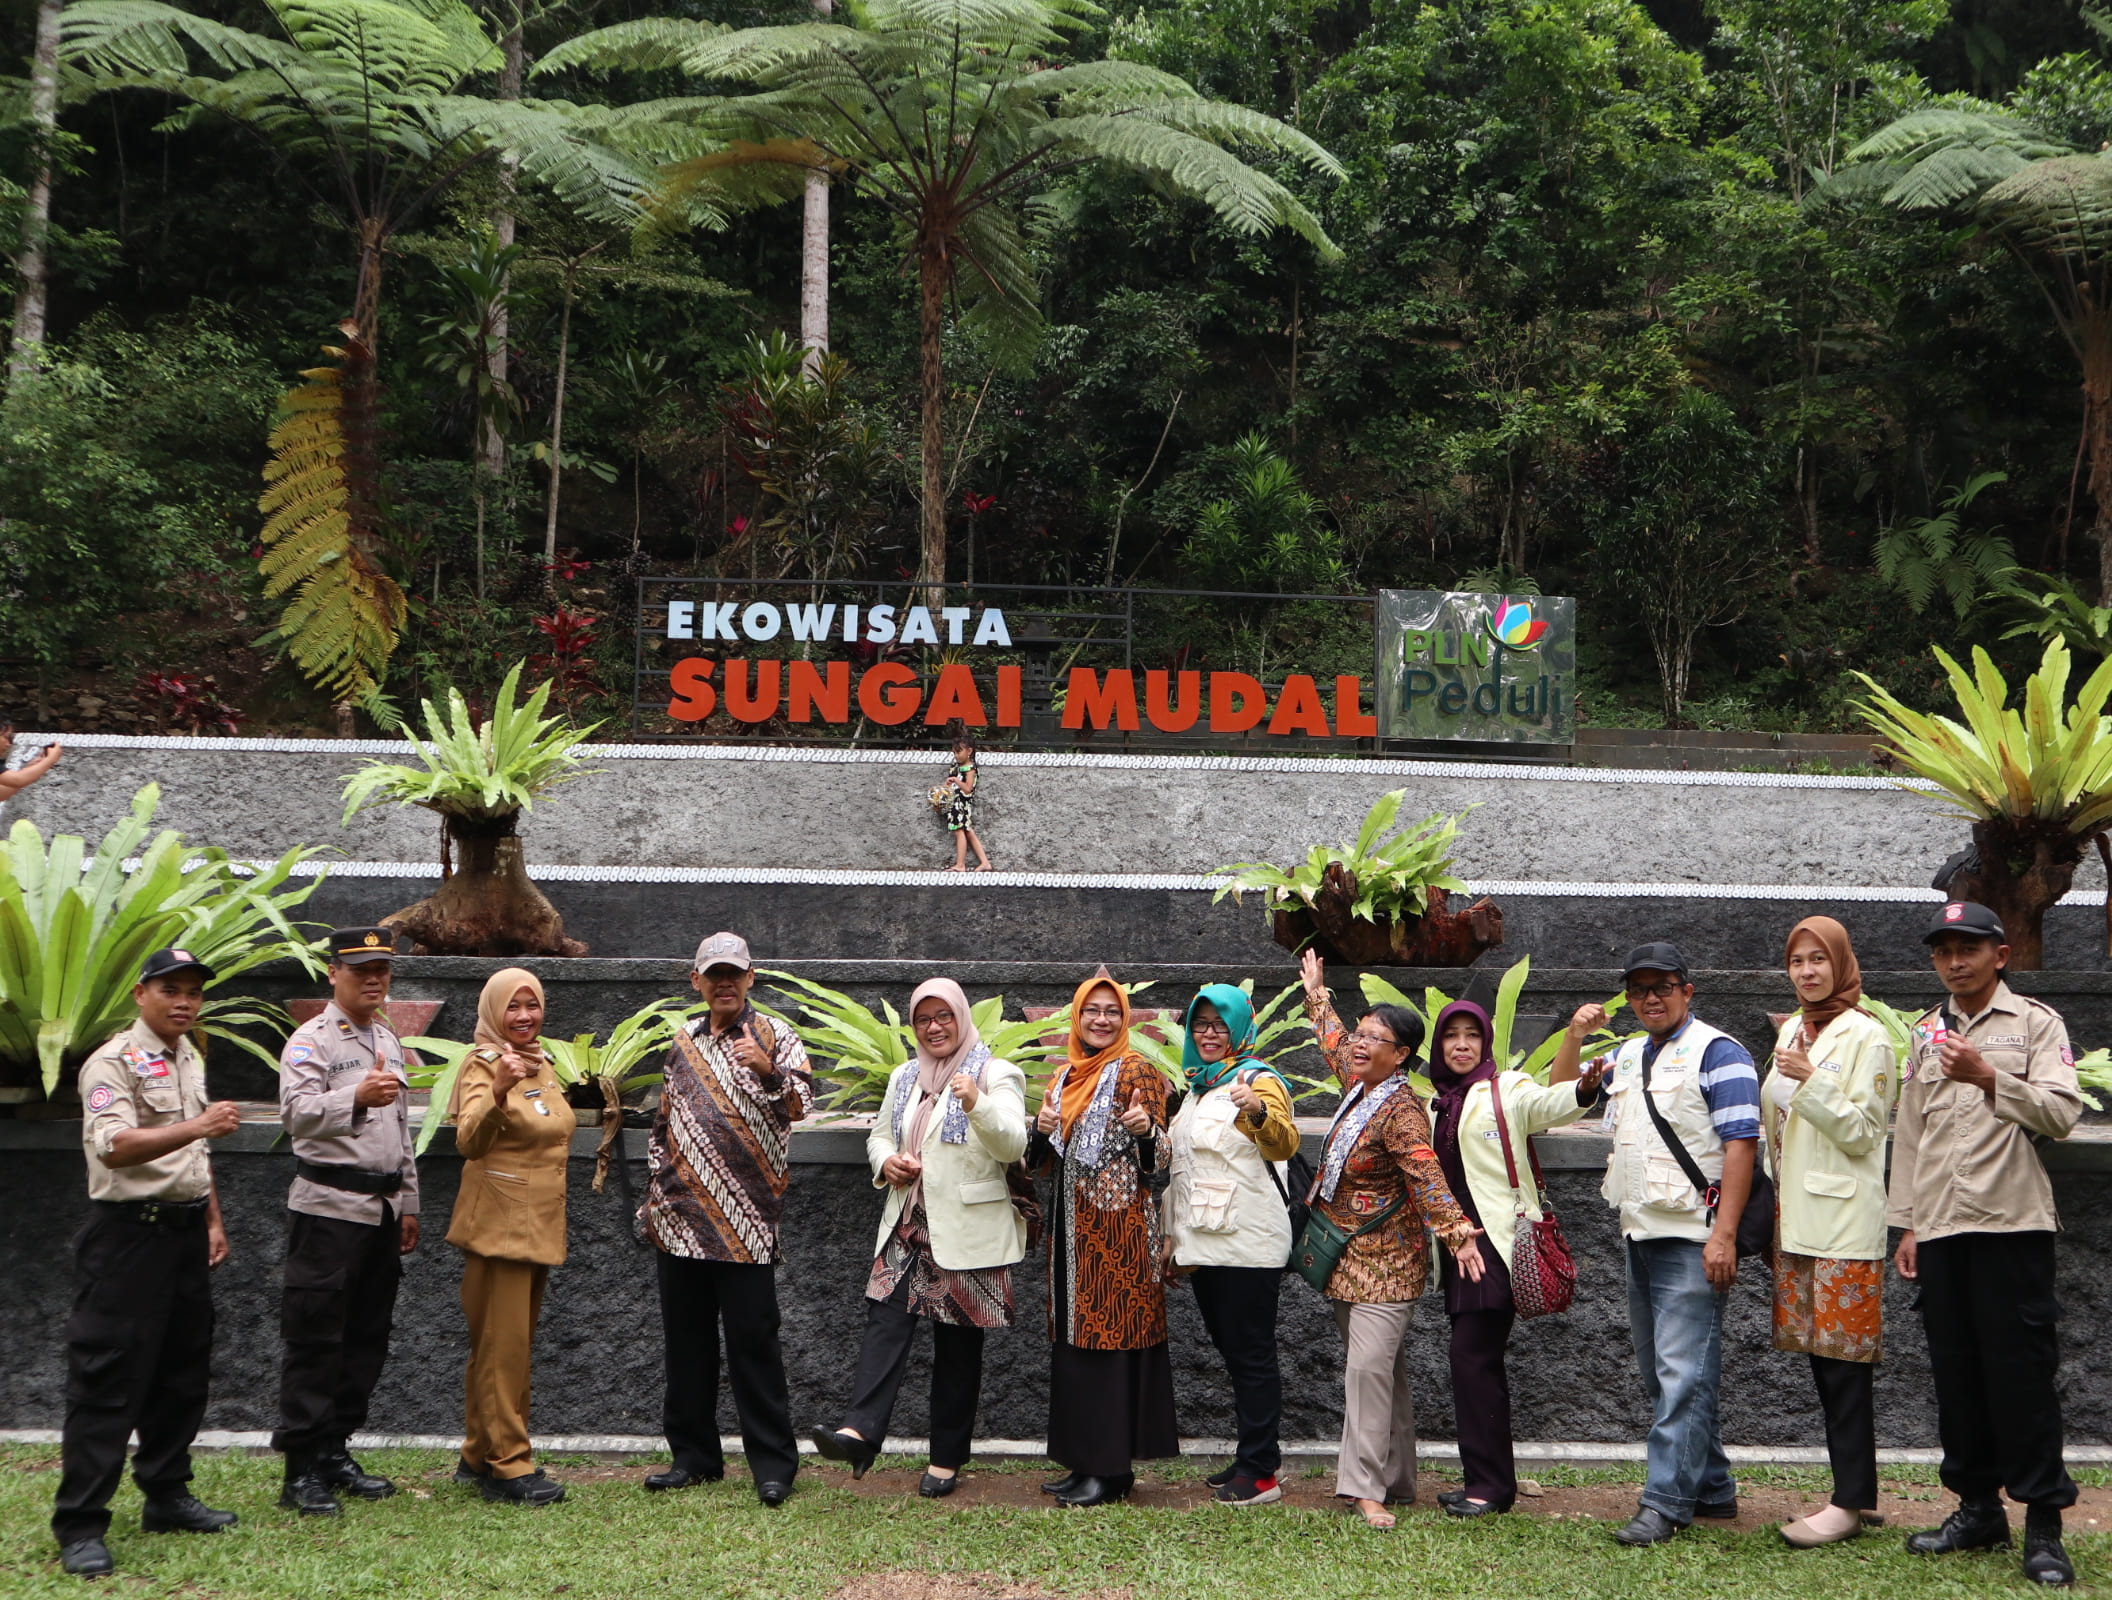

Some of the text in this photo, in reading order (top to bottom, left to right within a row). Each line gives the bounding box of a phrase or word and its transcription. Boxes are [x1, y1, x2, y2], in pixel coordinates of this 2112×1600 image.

[667, 600, 1013, 646] EKOWISATA
[1404, 628, 1489, 667] PLN
[666, 657, 1377, 737] SUNGAI MUDAL
[1402, 645, 1562, 717] Peduli
[1989, 1035, 2022, 1044] TAGANA
